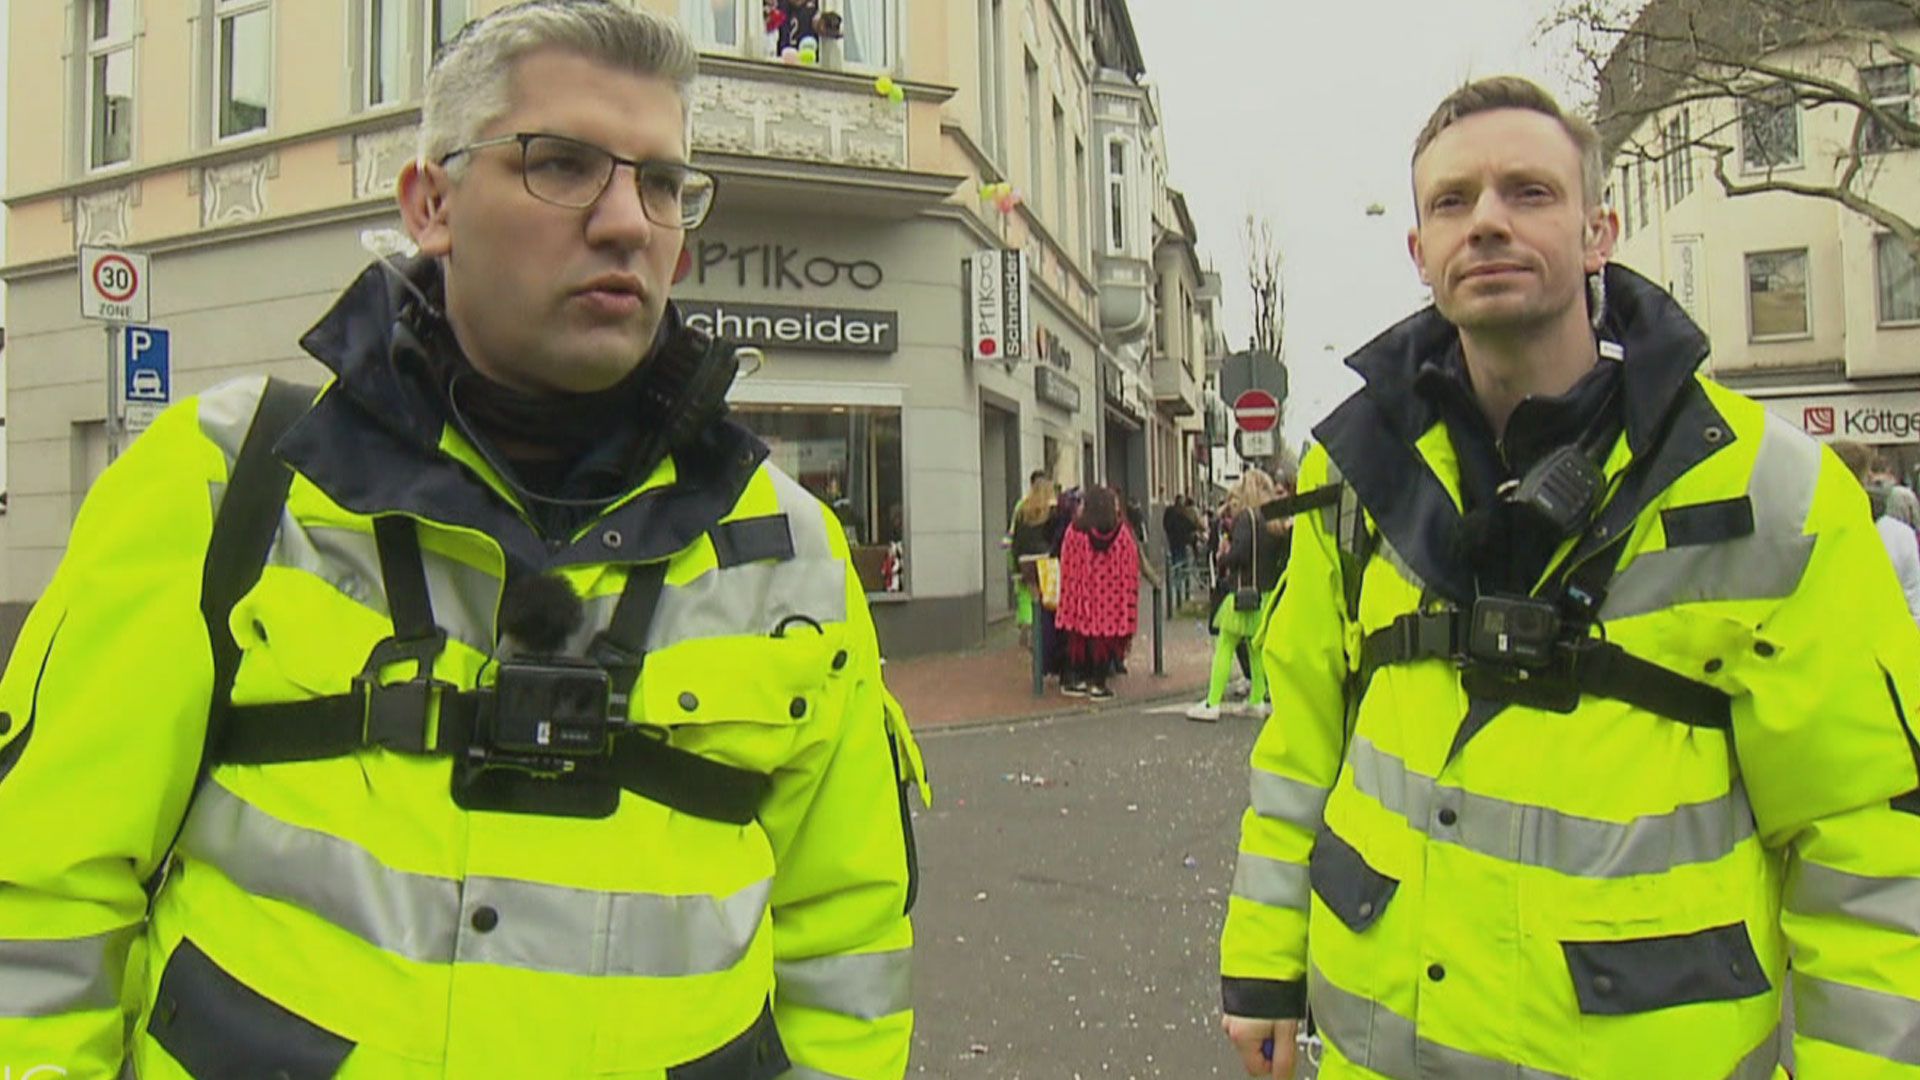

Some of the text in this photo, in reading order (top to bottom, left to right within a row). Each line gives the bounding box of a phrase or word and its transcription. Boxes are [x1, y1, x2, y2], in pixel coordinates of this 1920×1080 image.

[102, 266, 129, 290] 30
[99, 303, 132, 318] ZONE
[1006, 251, 1020, 356] Schneider
[686, 308, 889, 344] chneider
[131, 330, 151, 361] P
